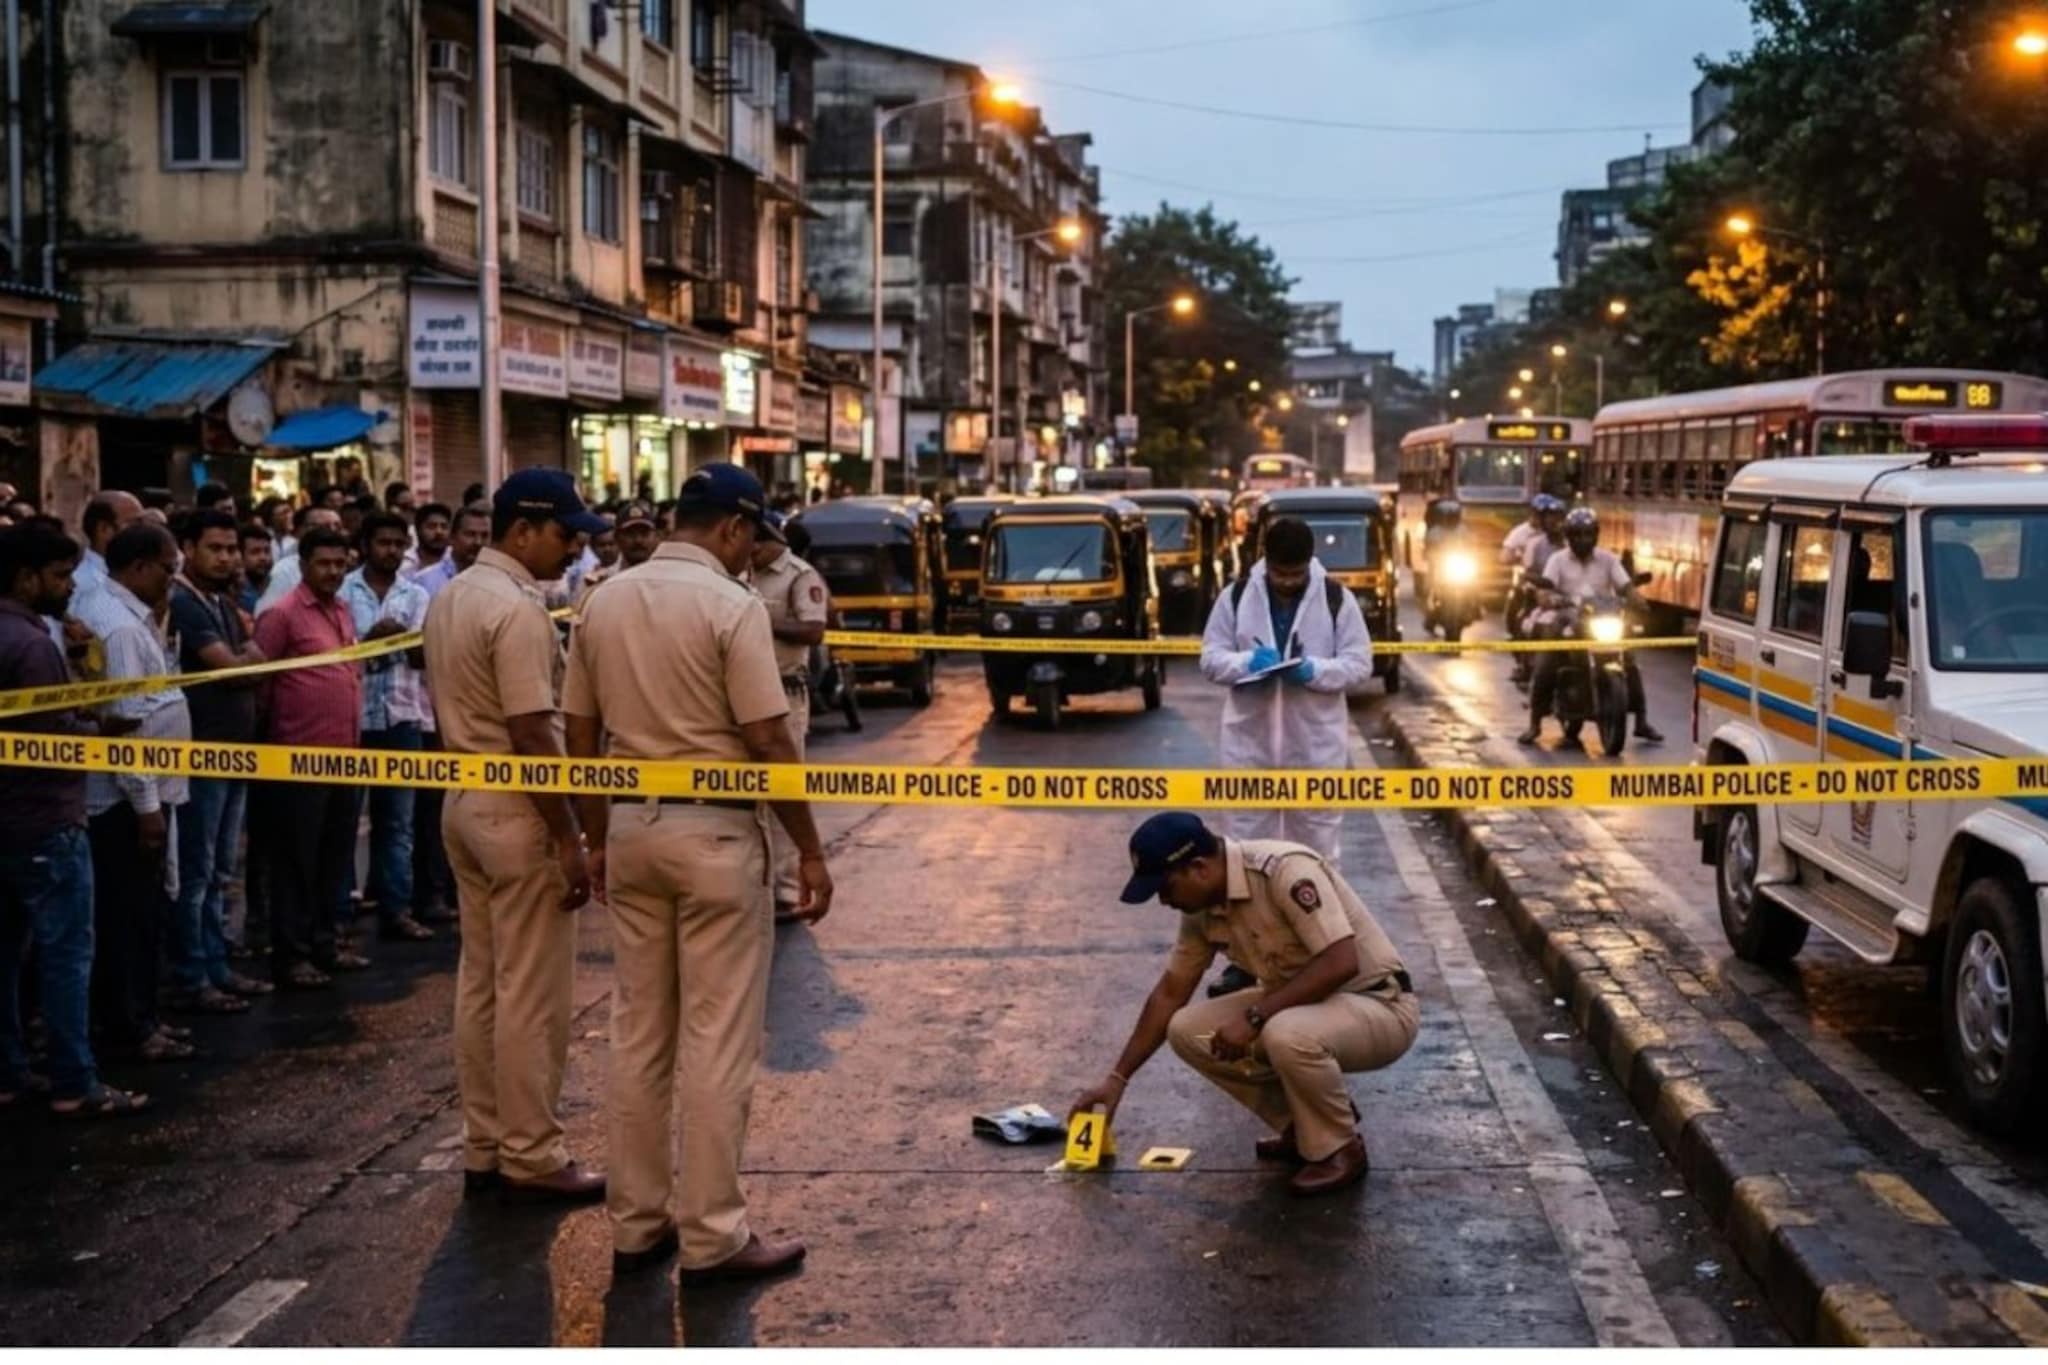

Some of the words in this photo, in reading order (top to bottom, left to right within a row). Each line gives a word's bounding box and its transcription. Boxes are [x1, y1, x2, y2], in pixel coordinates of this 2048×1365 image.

[13, 738, 86, 764] POLICE
[108, 744, 136, 766] DO
[143, 746, 182, 769] NOT
[189, 749, 258, 773] CROSS
[290, 753, 379, 778] MUMBAI
[386, 757, 460, 781] POLICE
[485, 762, 512, 784] DO
[520, 764, 561, 785] NOT
[569, 765, 639, 789] CROSS
[692, 768, 769, 792] POLICE
[805, 771, 896, 795] MUMBAI
[905, 774, 982, 797] POLICE
[1007, 776, 1036, 797] DO
[1044, 776, 1087, 798] NOT
[1097, 776, 1168, 799] CROSS
[1610, 774, 1704, 797] MUMBAI
[1712, 771, 1792, 795] POLICE
[1816, 770, 1846, 793] DO
[1855, 769, 1899, 792] NOT
[1906, 766, 1980, 791] CROSS
[1204, 777, 1297, 800] MUMBAI
[1306, 777, 1385, 800] POLICE
[1411, 777, 1440, 799] DO
[1449, 777, 1492, 800] NOT
[1500, 776, 1573, 799] CROSS
[1075, 1121, 1093, 1151] 4
